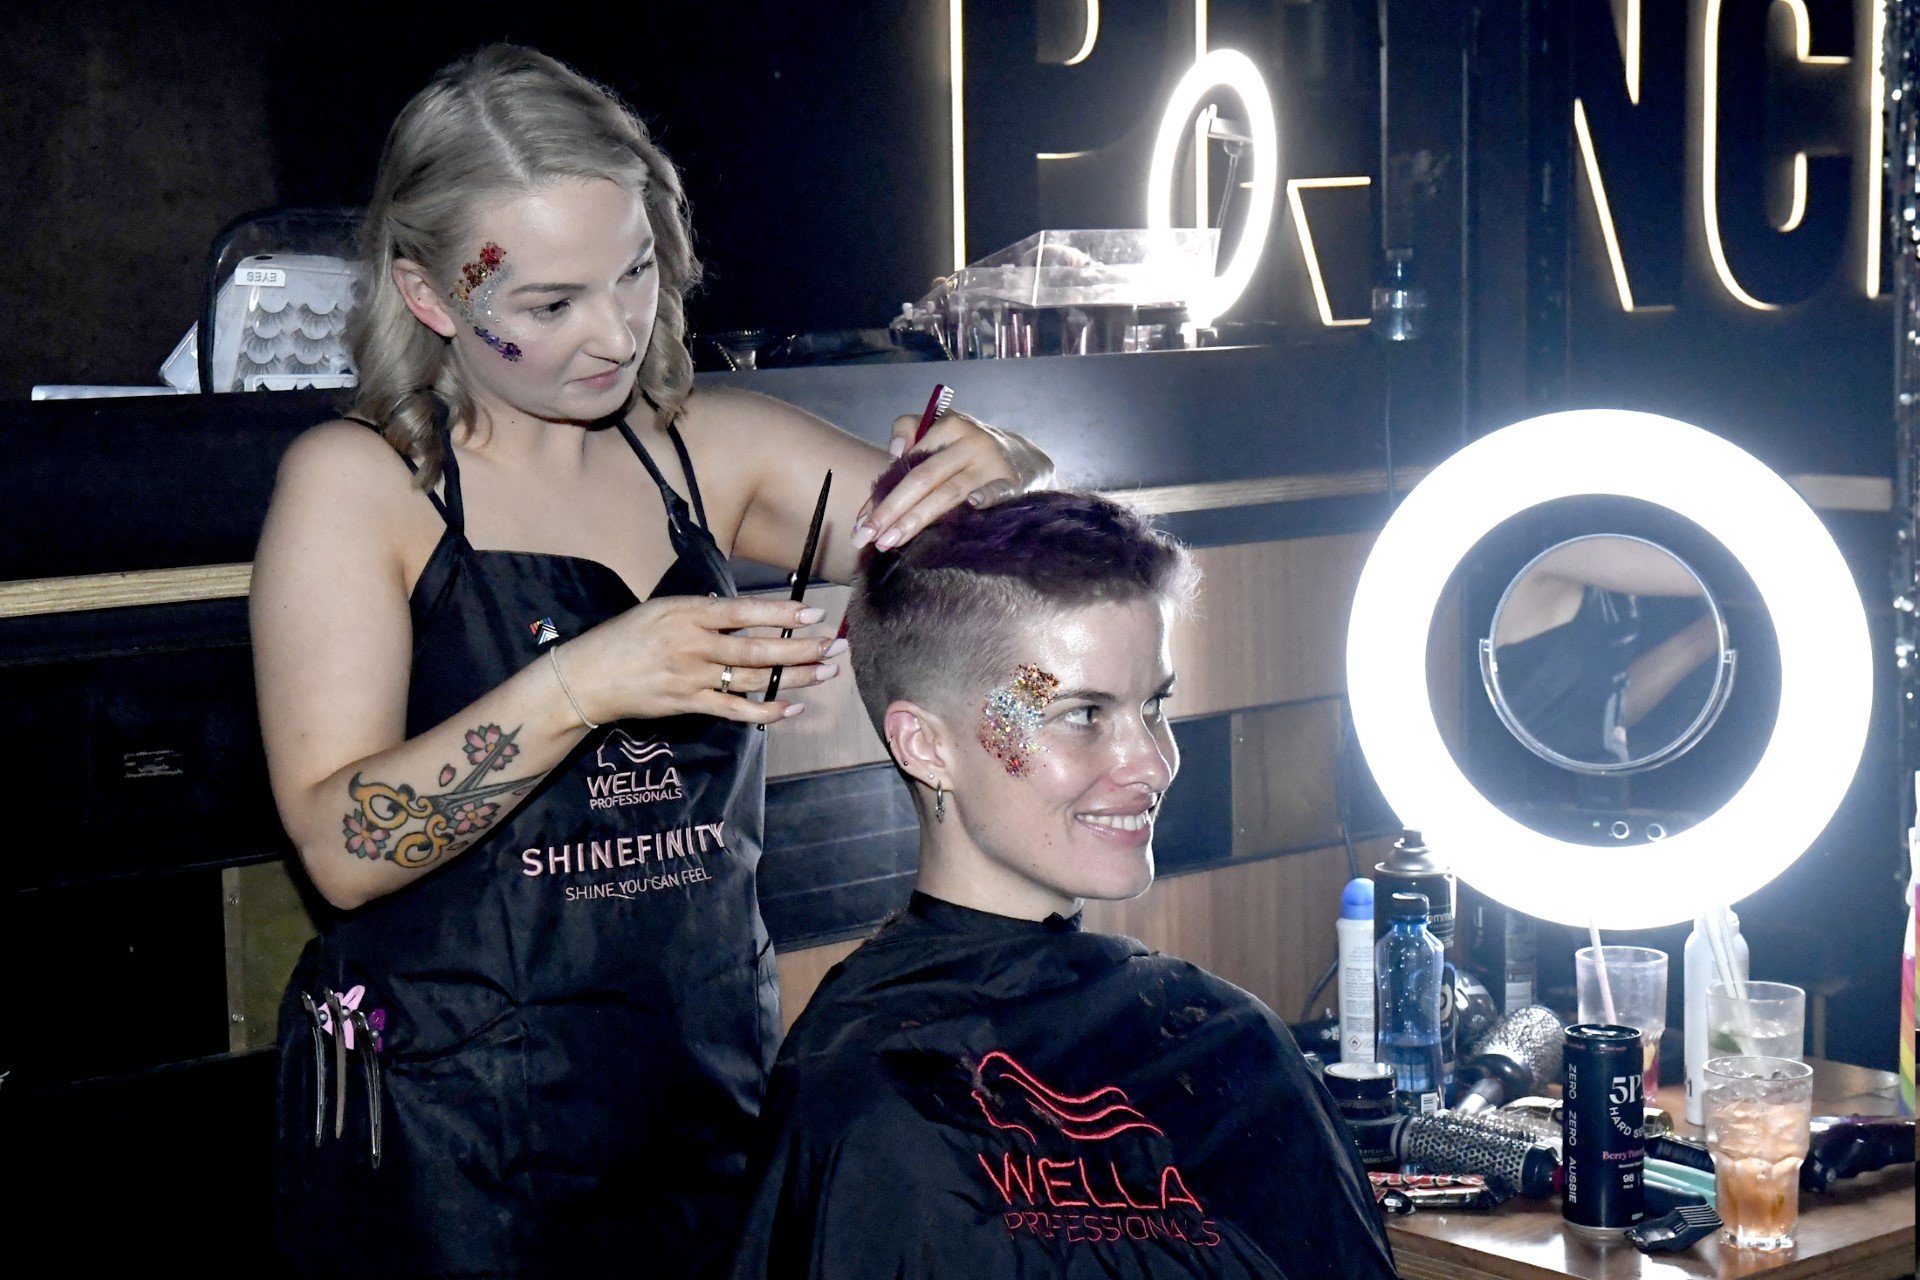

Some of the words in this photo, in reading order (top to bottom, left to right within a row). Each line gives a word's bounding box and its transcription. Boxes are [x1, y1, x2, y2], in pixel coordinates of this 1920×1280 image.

[247, 271, 278, 283] EYES
[586, 767, 683, 798] WELLA
[589, 788, 683, 810] PROFESSIONALS
[521, 821, 725, 877] SHINEFINITY
[565, 882, 615, 902] SHINE
[618, 878, 649, 895] YOU
[651, 873, 681, 891] CAN
[681, 867, 712, 885] FEEL
[1568, 1063, 1577, 1100] ZERO
[1568, 1111, 1577, 1147] ZERO
[1609, 1106, 1632, 1136] HARD
[1602, 1151, 1627, 1161] Berry
[977, 1152, 1204, 1213] WELLA
[1568, 1156, 1577, 1204] AUSSIE
[1622, 1173, 1635, 1183] 98
